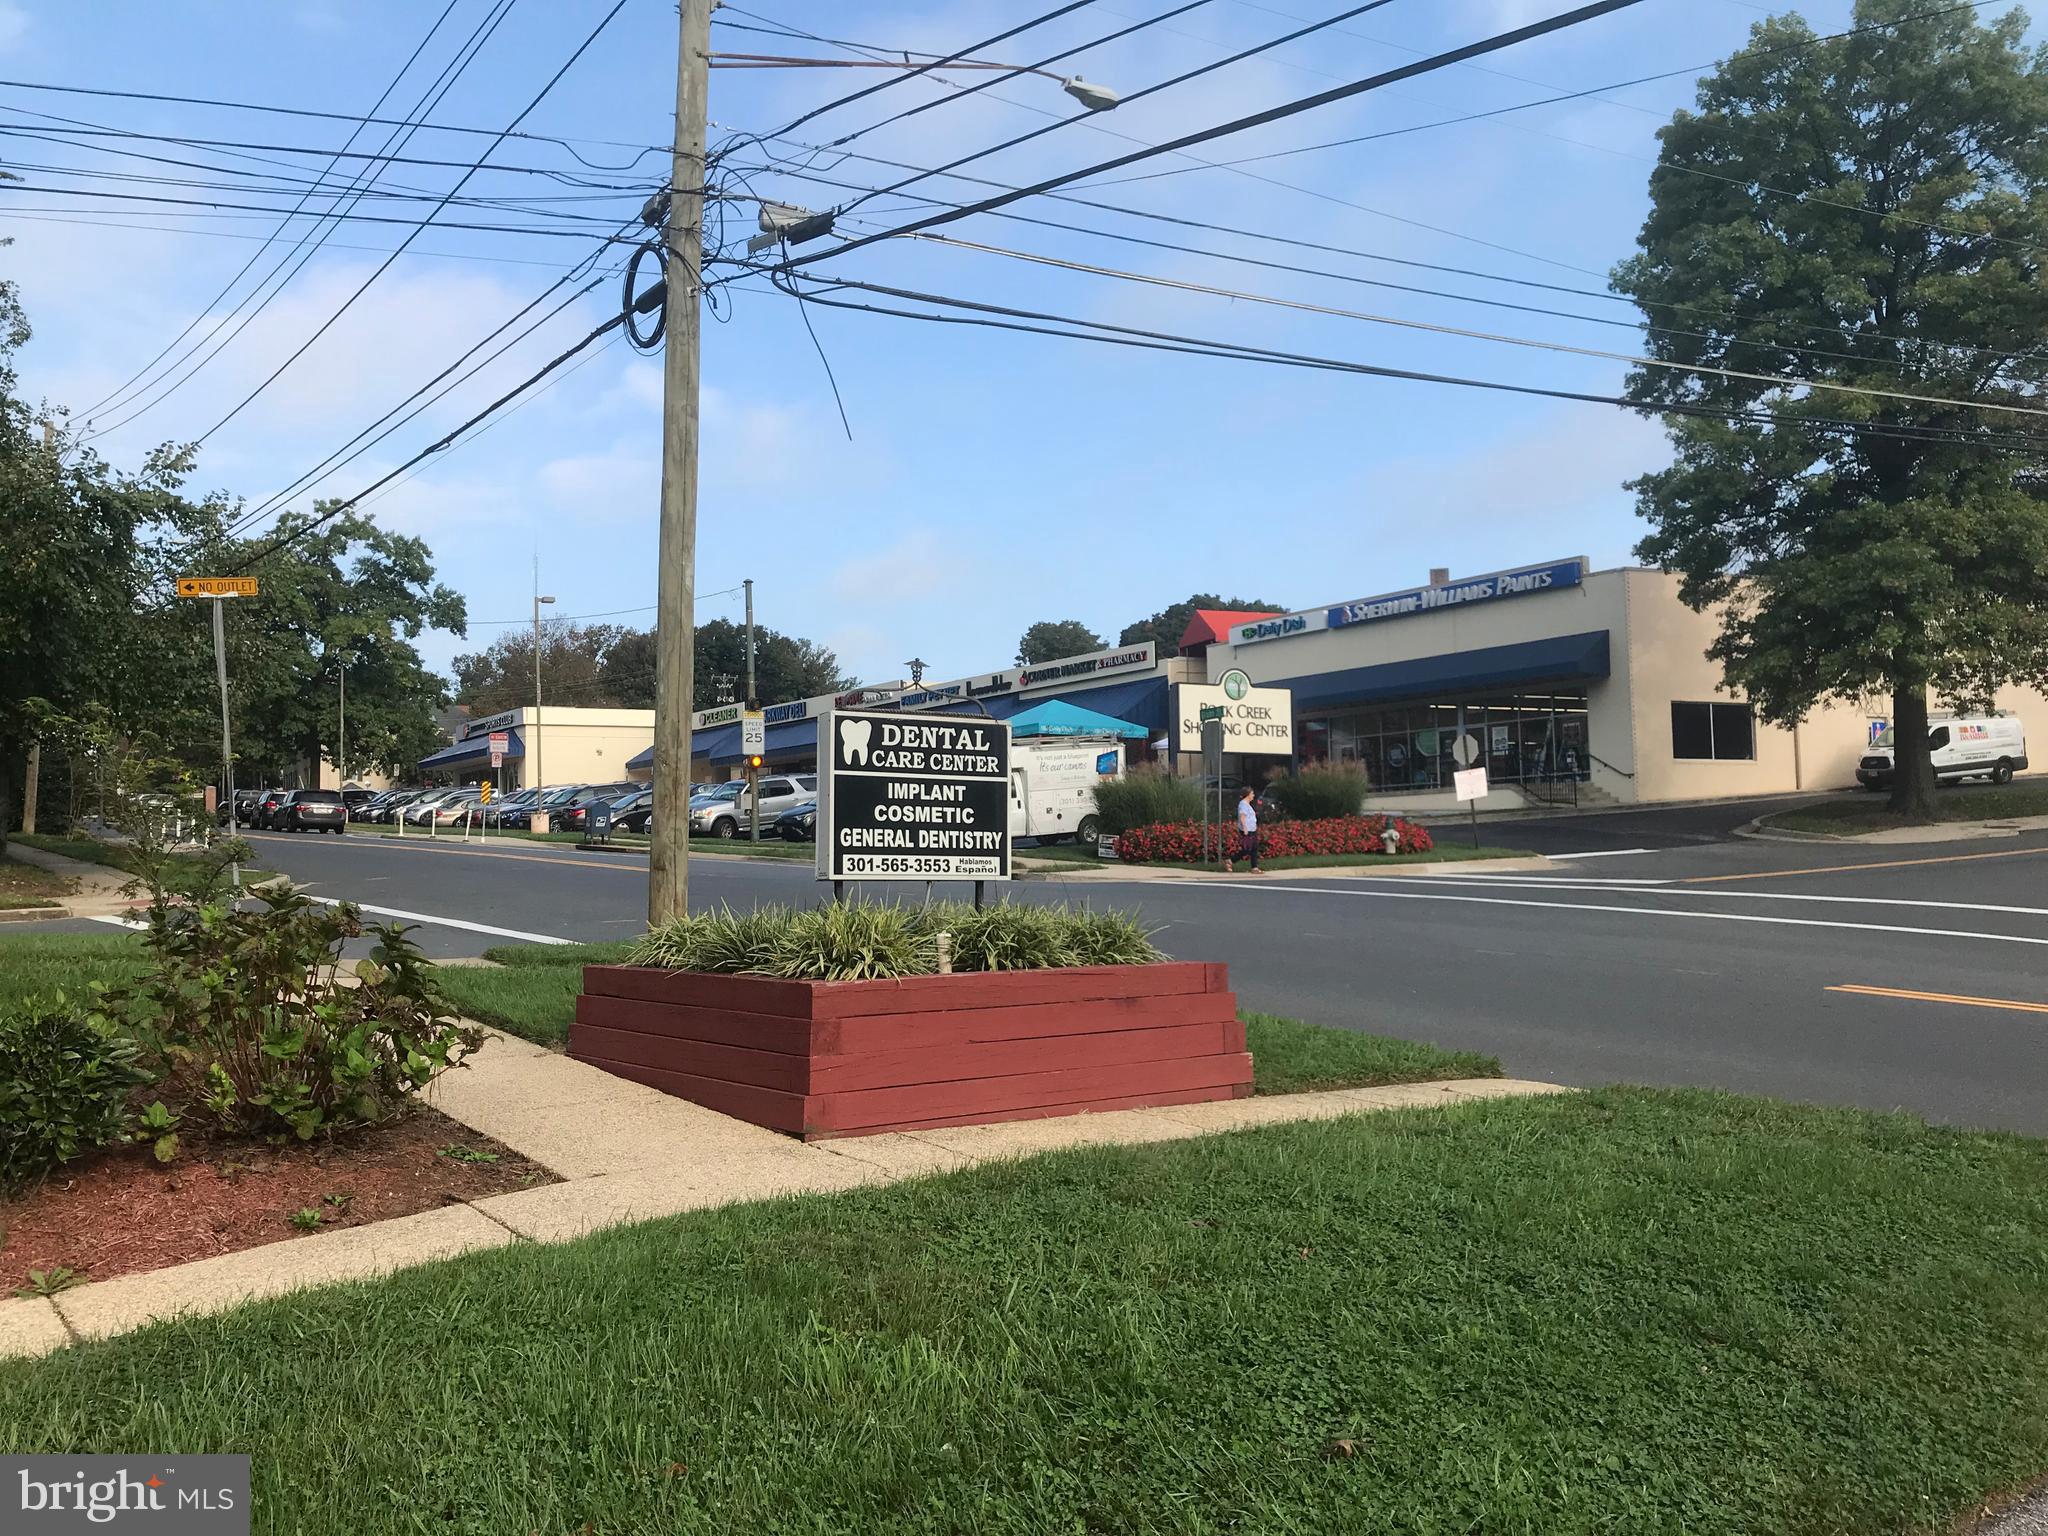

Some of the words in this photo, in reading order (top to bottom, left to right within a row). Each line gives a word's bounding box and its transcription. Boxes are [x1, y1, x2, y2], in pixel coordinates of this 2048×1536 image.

[199, 582, 212, 592] NO
[217, 581, 253, 592] OUTLET
[1353, 580, 1494, 622] SHERWIN-WILLIAMS
[1496, 571, 1552, 595] PAINTS
[1283, 616, 1306, 633] Dish
[1103, 650, 1147, 667] PHARMACY
[1237, 704, 1272, 720] CREEK
[745, 733, 762, 743] 25
[881, 724, 990, 751] DENTAL
[1246, 722, 1288, 738] CENTER
[872, 750, 925, 769] CARE
[929, 753, 999, 773] CENTER
[887, 782, 966, 801] IMPLANT
[874, 804, 975, 824] COSMETIC
[840, 828, 914, 848] GENERAL
[918, 829, 1003, 849] DENTISTRY
[847, 857, 951, 873] 301-565-3553
[956, 866, 997, 874] Español
